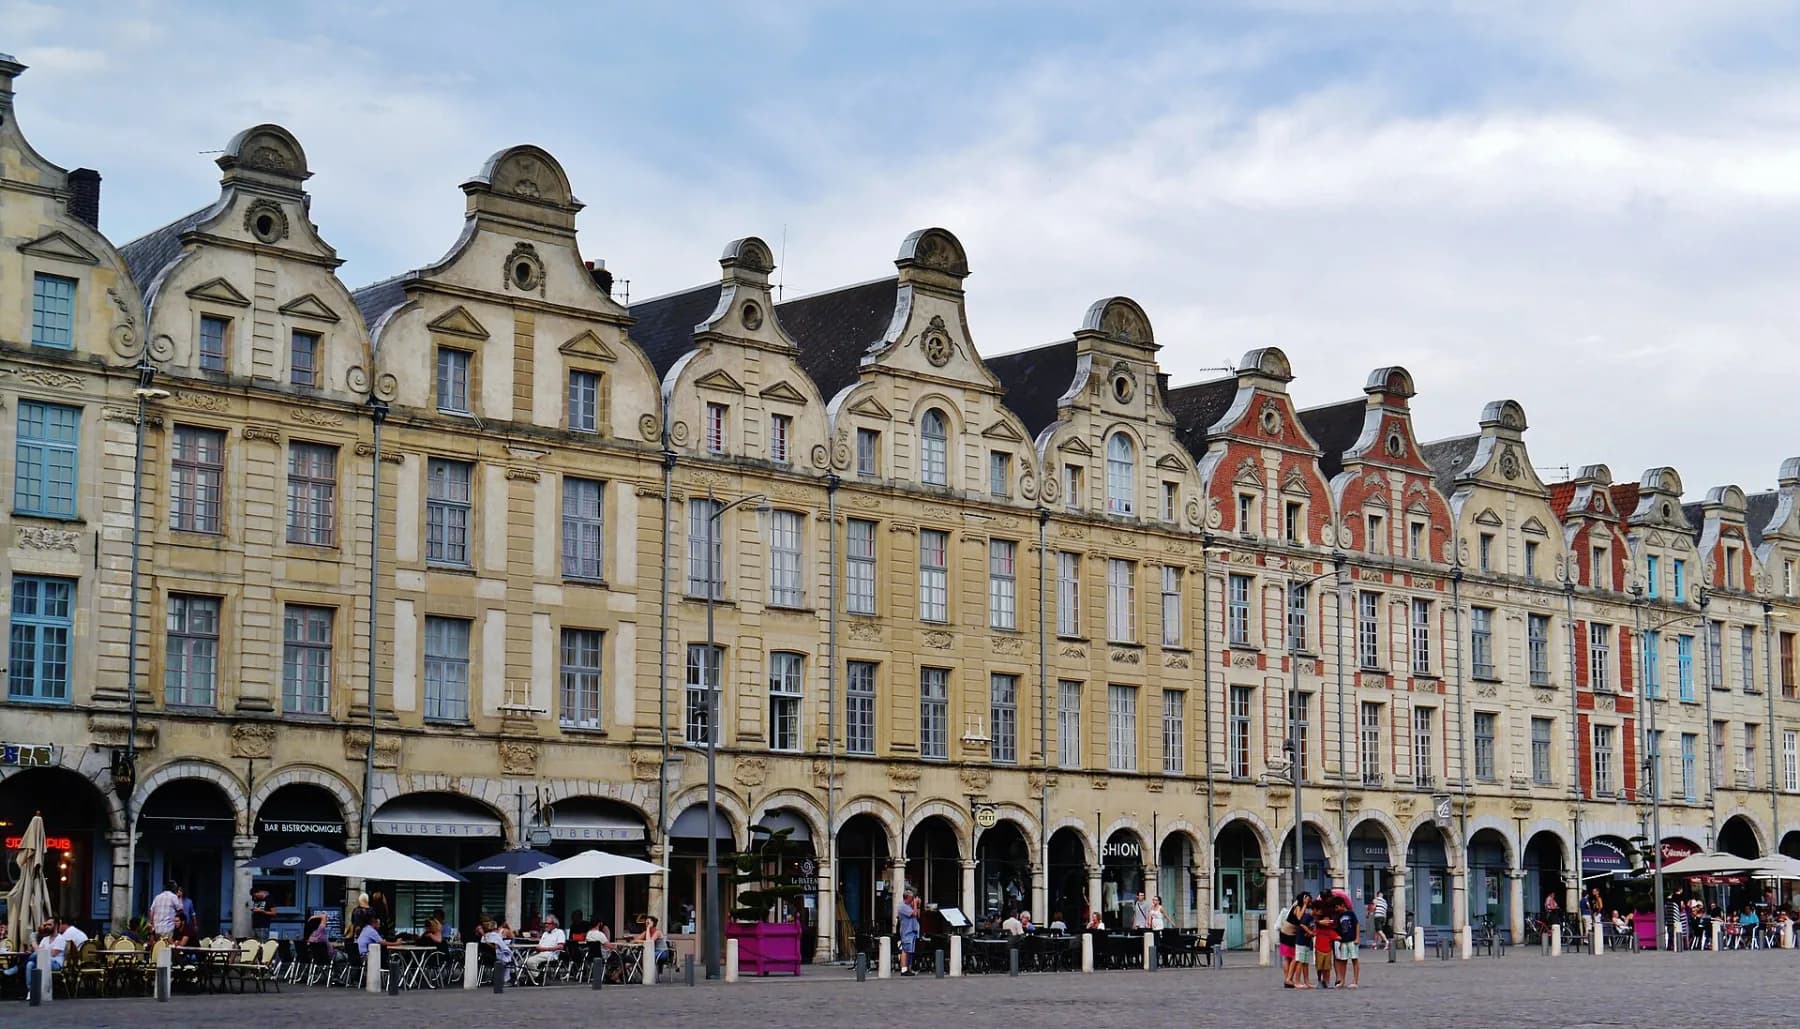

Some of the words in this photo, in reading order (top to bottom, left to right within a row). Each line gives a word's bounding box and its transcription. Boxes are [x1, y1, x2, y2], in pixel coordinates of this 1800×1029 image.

[264, 823, 279, 832] BAR
[281, 824, 342, 834] BISTRONOMIQUE
[390, 824, 470, 834] HUBERT
[556, 829, 615, 839] UBERT
[1102, 842, 1139, 857] SHION
